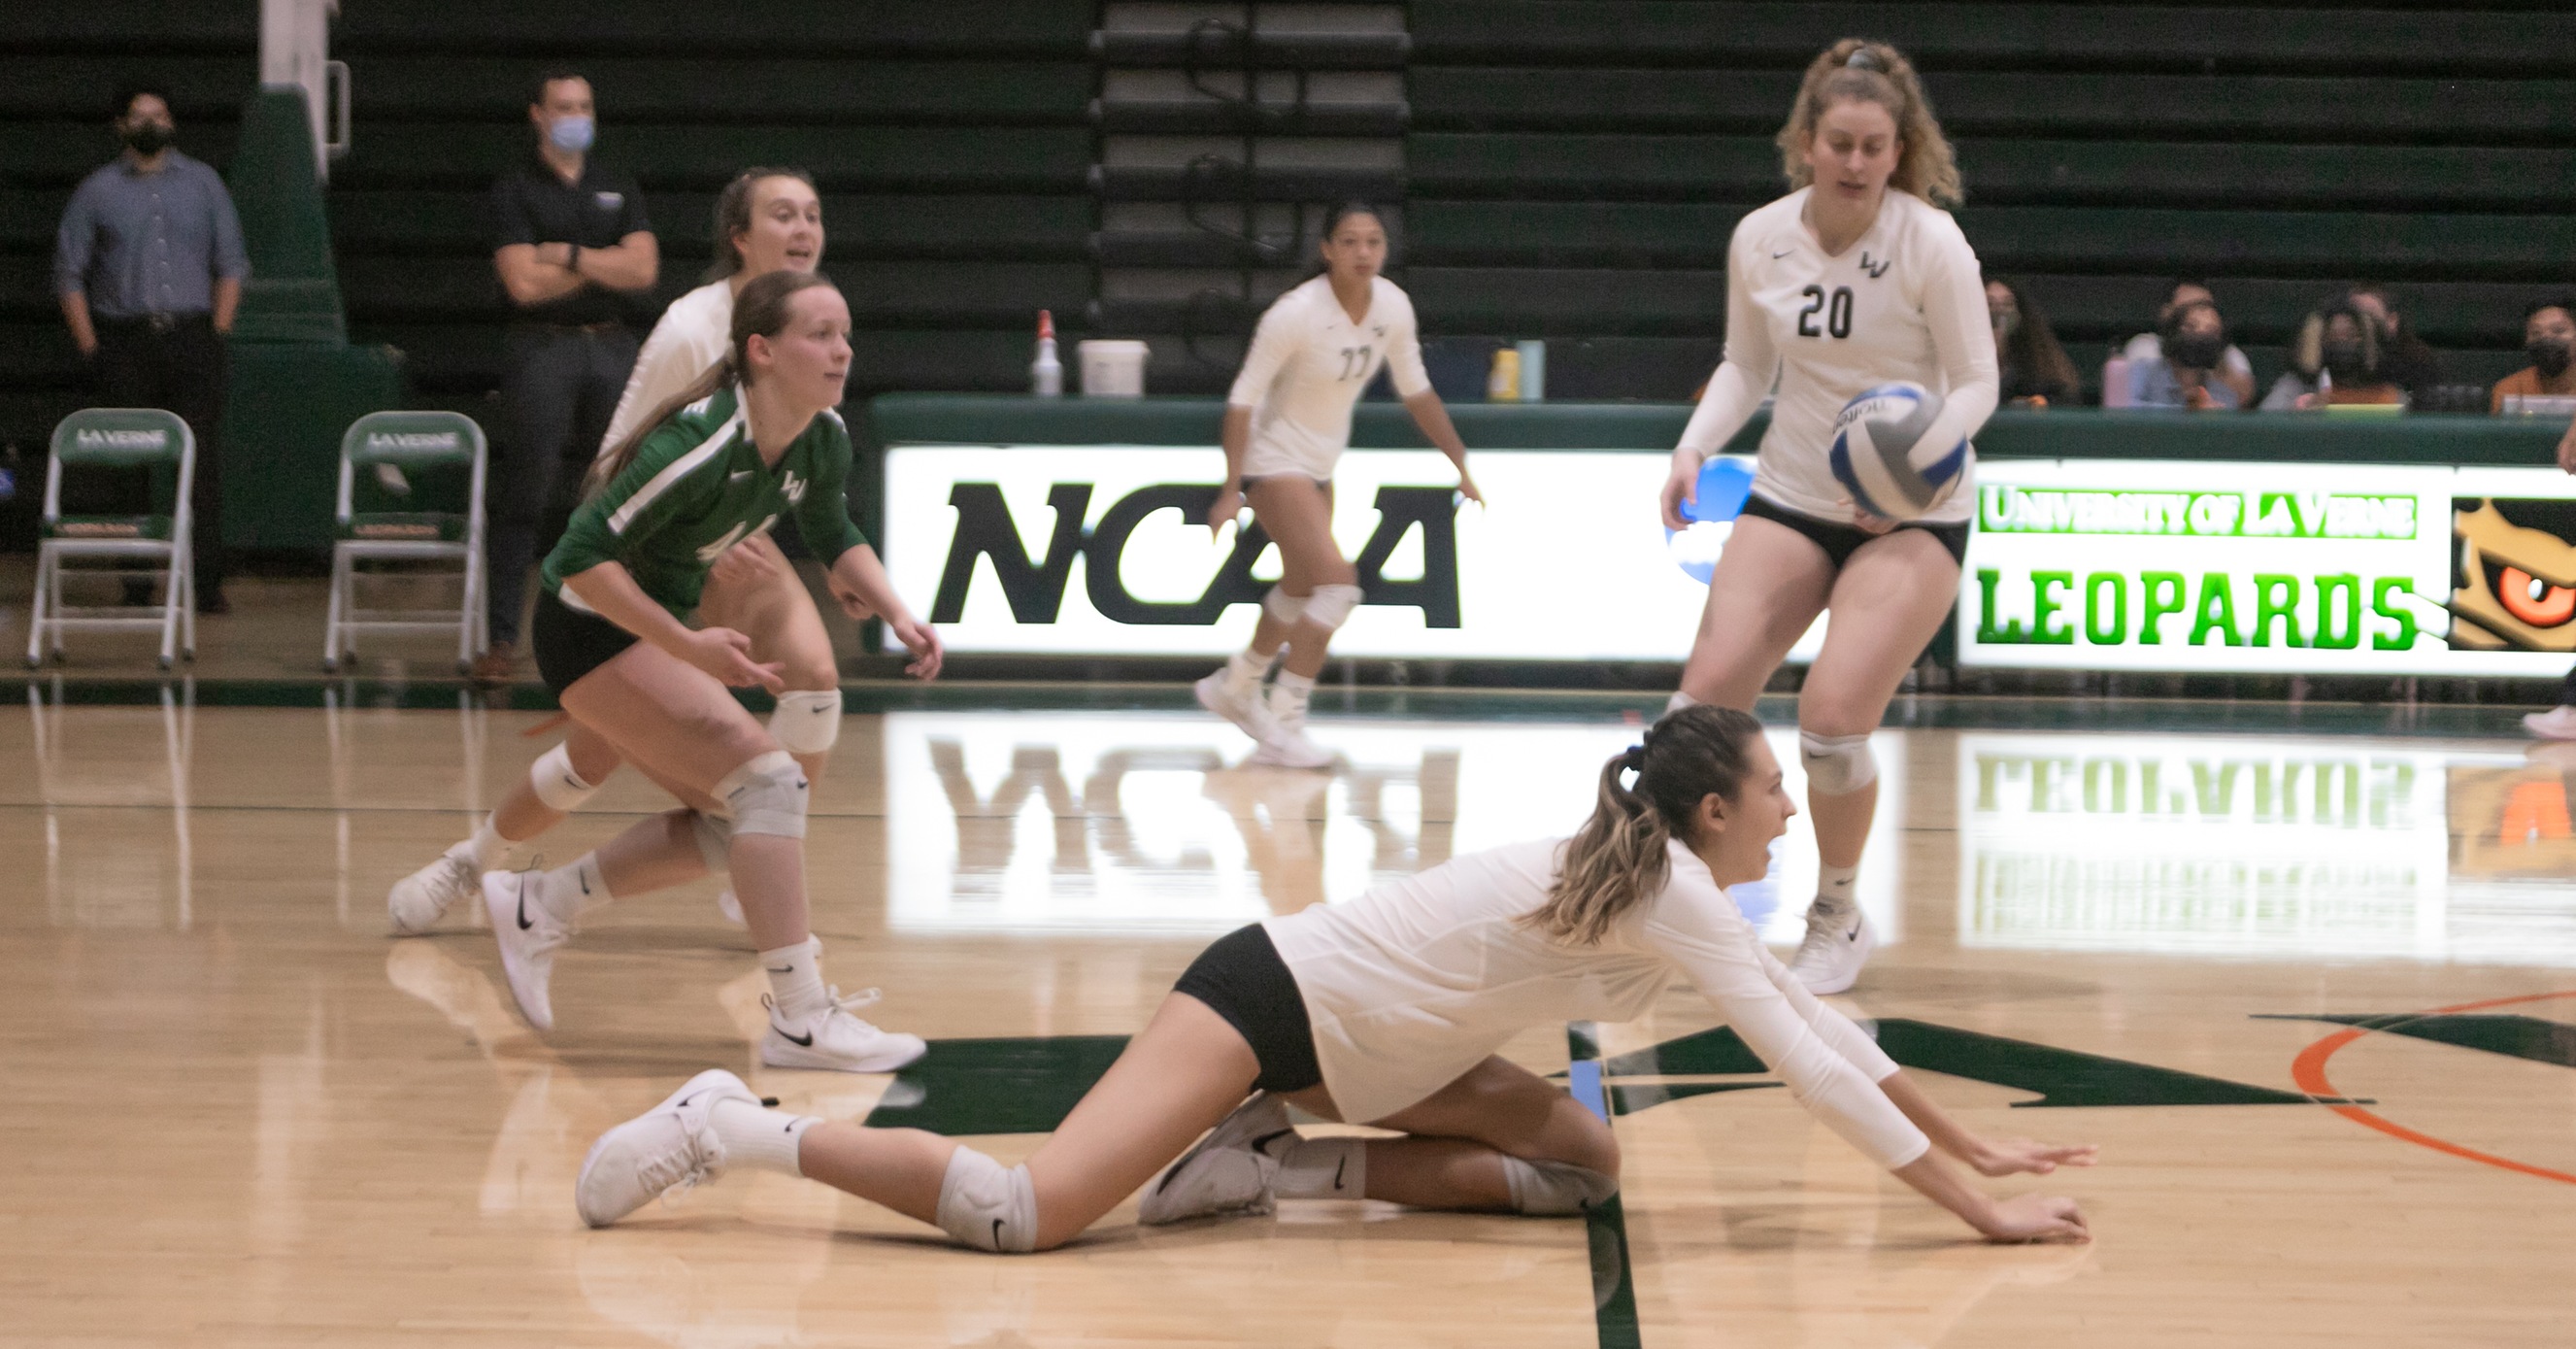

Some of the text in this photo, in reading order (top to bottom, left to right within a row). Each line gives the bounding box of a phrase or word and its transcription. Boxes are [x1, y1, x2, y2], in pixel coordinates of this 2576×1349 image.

[1798, 284, 1854, 339] 20
[2189, 492, 2242, 535] OF
[2242, 489, 2295, 536] LA
[2293, 489, 2416, 538] VERNE
[1977, 568, 2415, 652] LEOPARDS
